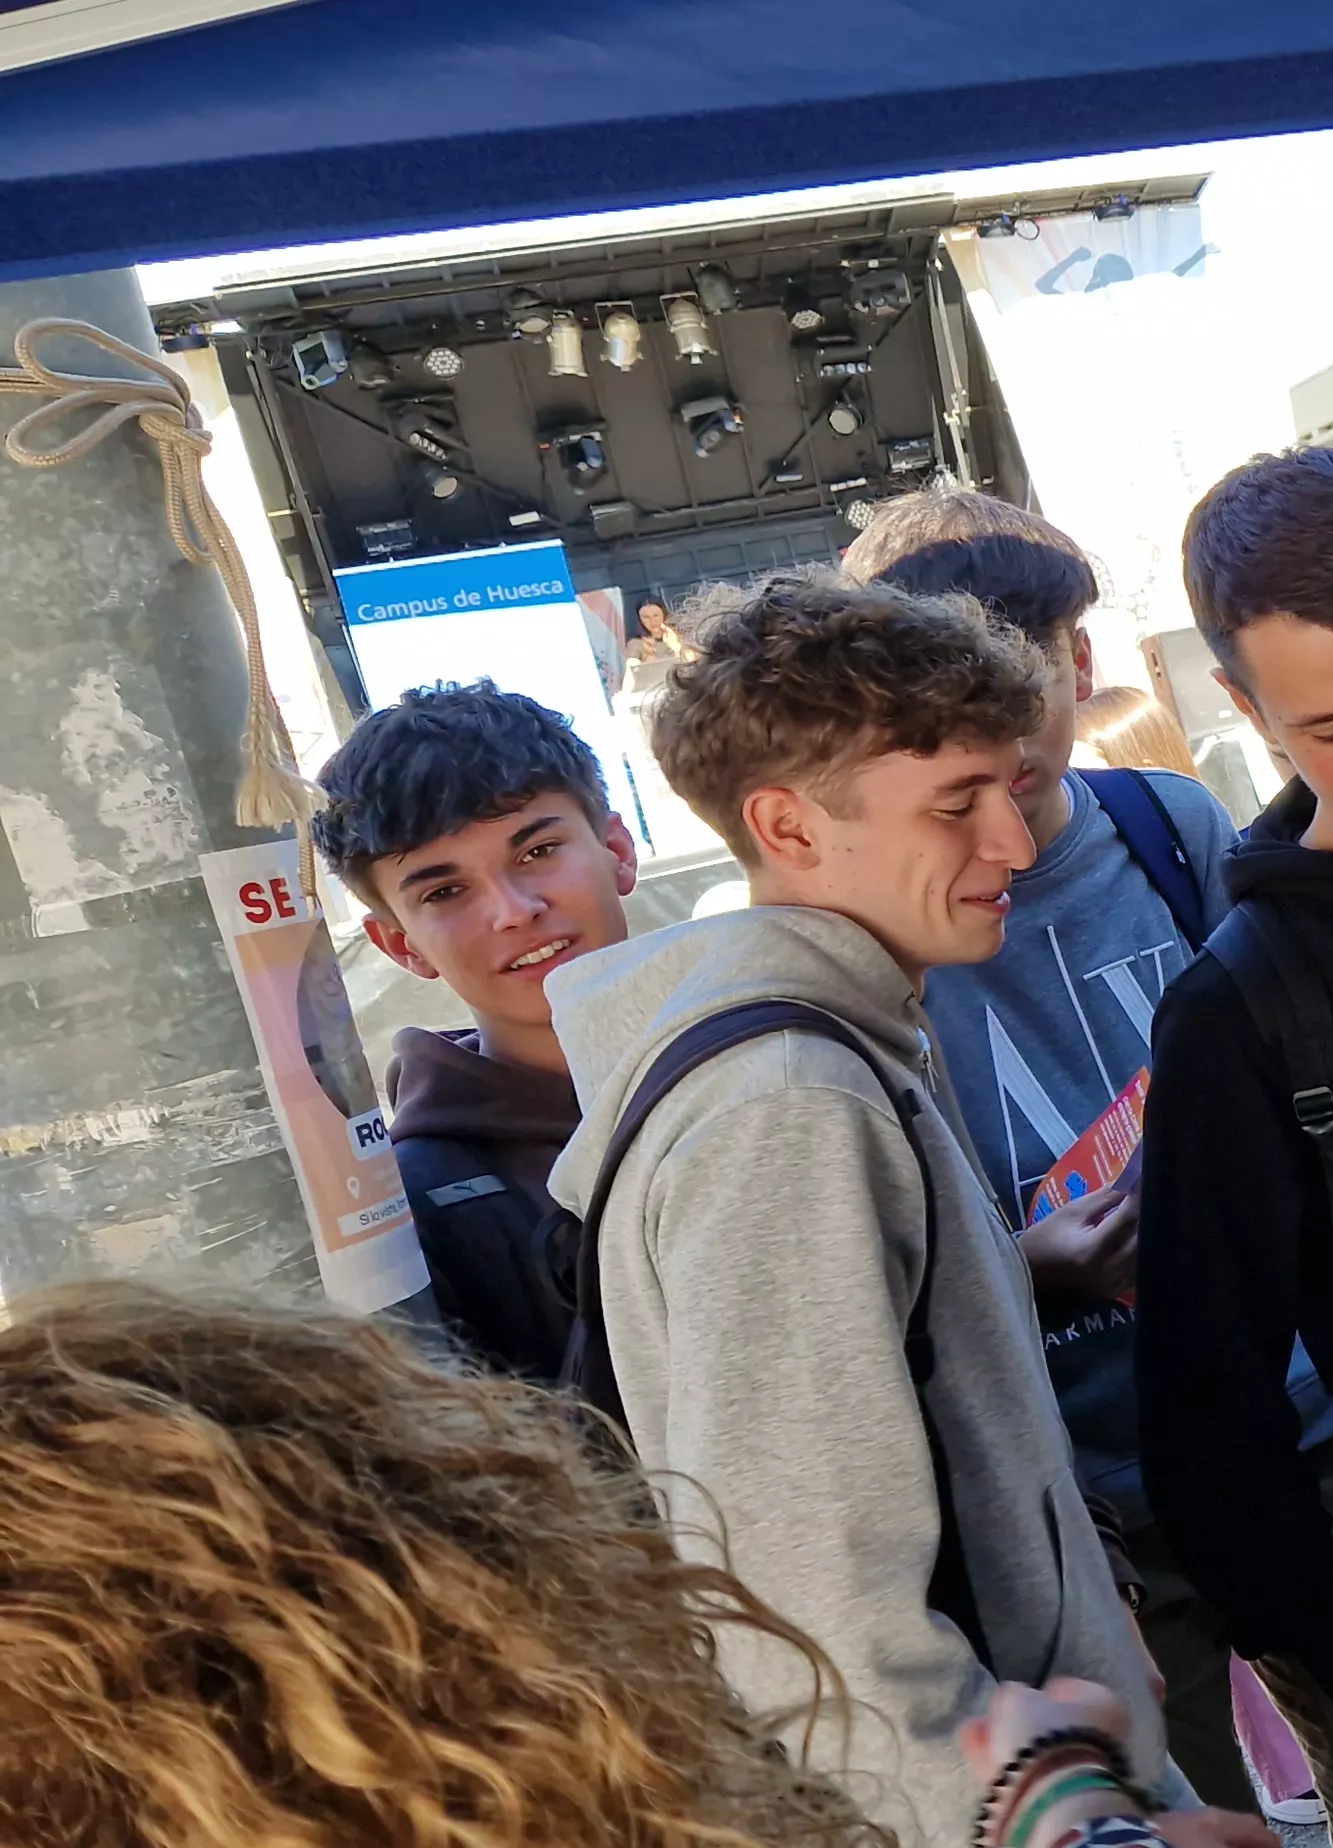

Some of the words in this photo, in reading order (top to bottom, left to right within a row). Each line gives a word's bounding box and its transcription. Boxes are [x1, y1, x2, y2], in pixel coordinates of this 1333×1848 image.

[357, 595, 449, 622] Campus
[453, 589, 482, 608] de
[486, 578, 565, 603] Huesca
[1044, 1307, 1136, 1350] ARMA
